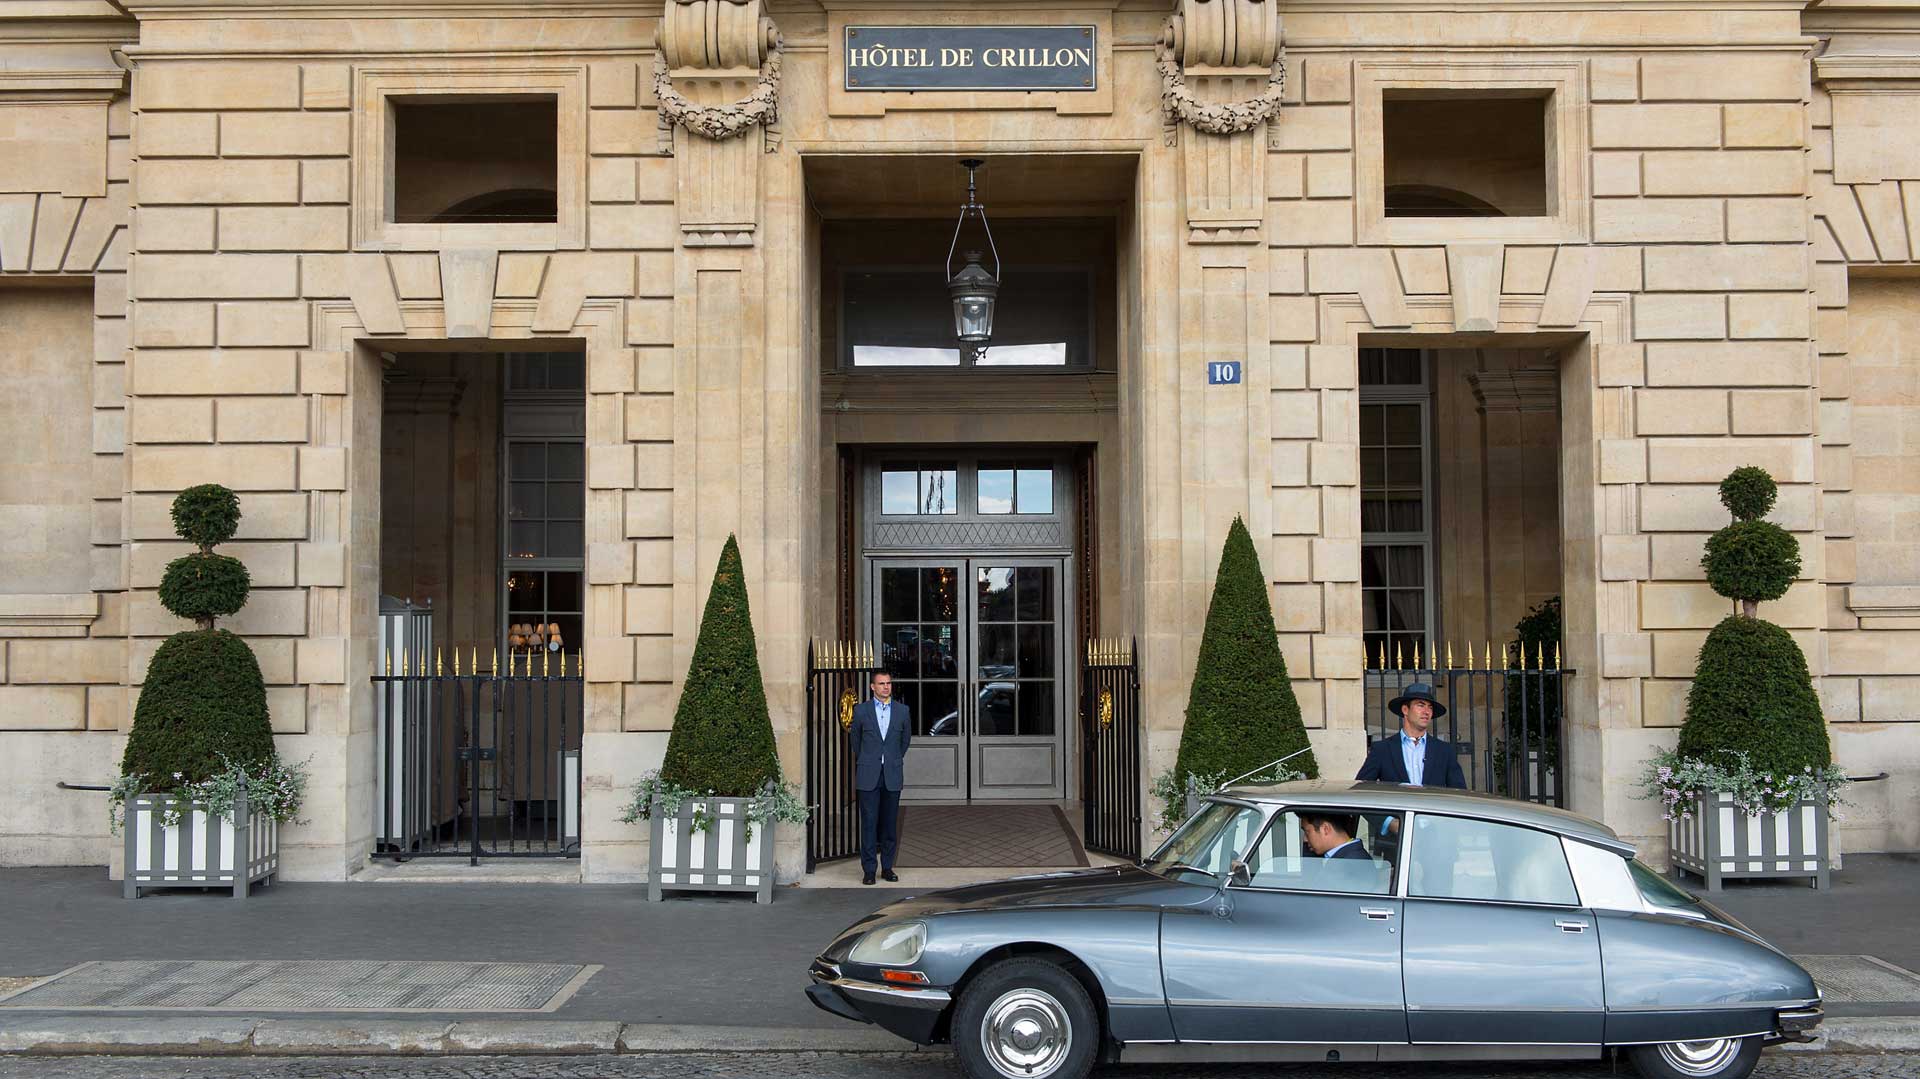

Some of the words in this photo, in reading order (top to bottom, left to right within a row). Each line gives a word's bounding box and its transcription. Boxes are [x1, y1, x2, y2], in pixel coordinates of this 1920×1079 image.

[849, 43, 934, 67] HÔTEL
[941, 48, 974, 67] DE
[982, 48, 1091, 67] CRILLON
[1215, 364, 1234, 382] 10
